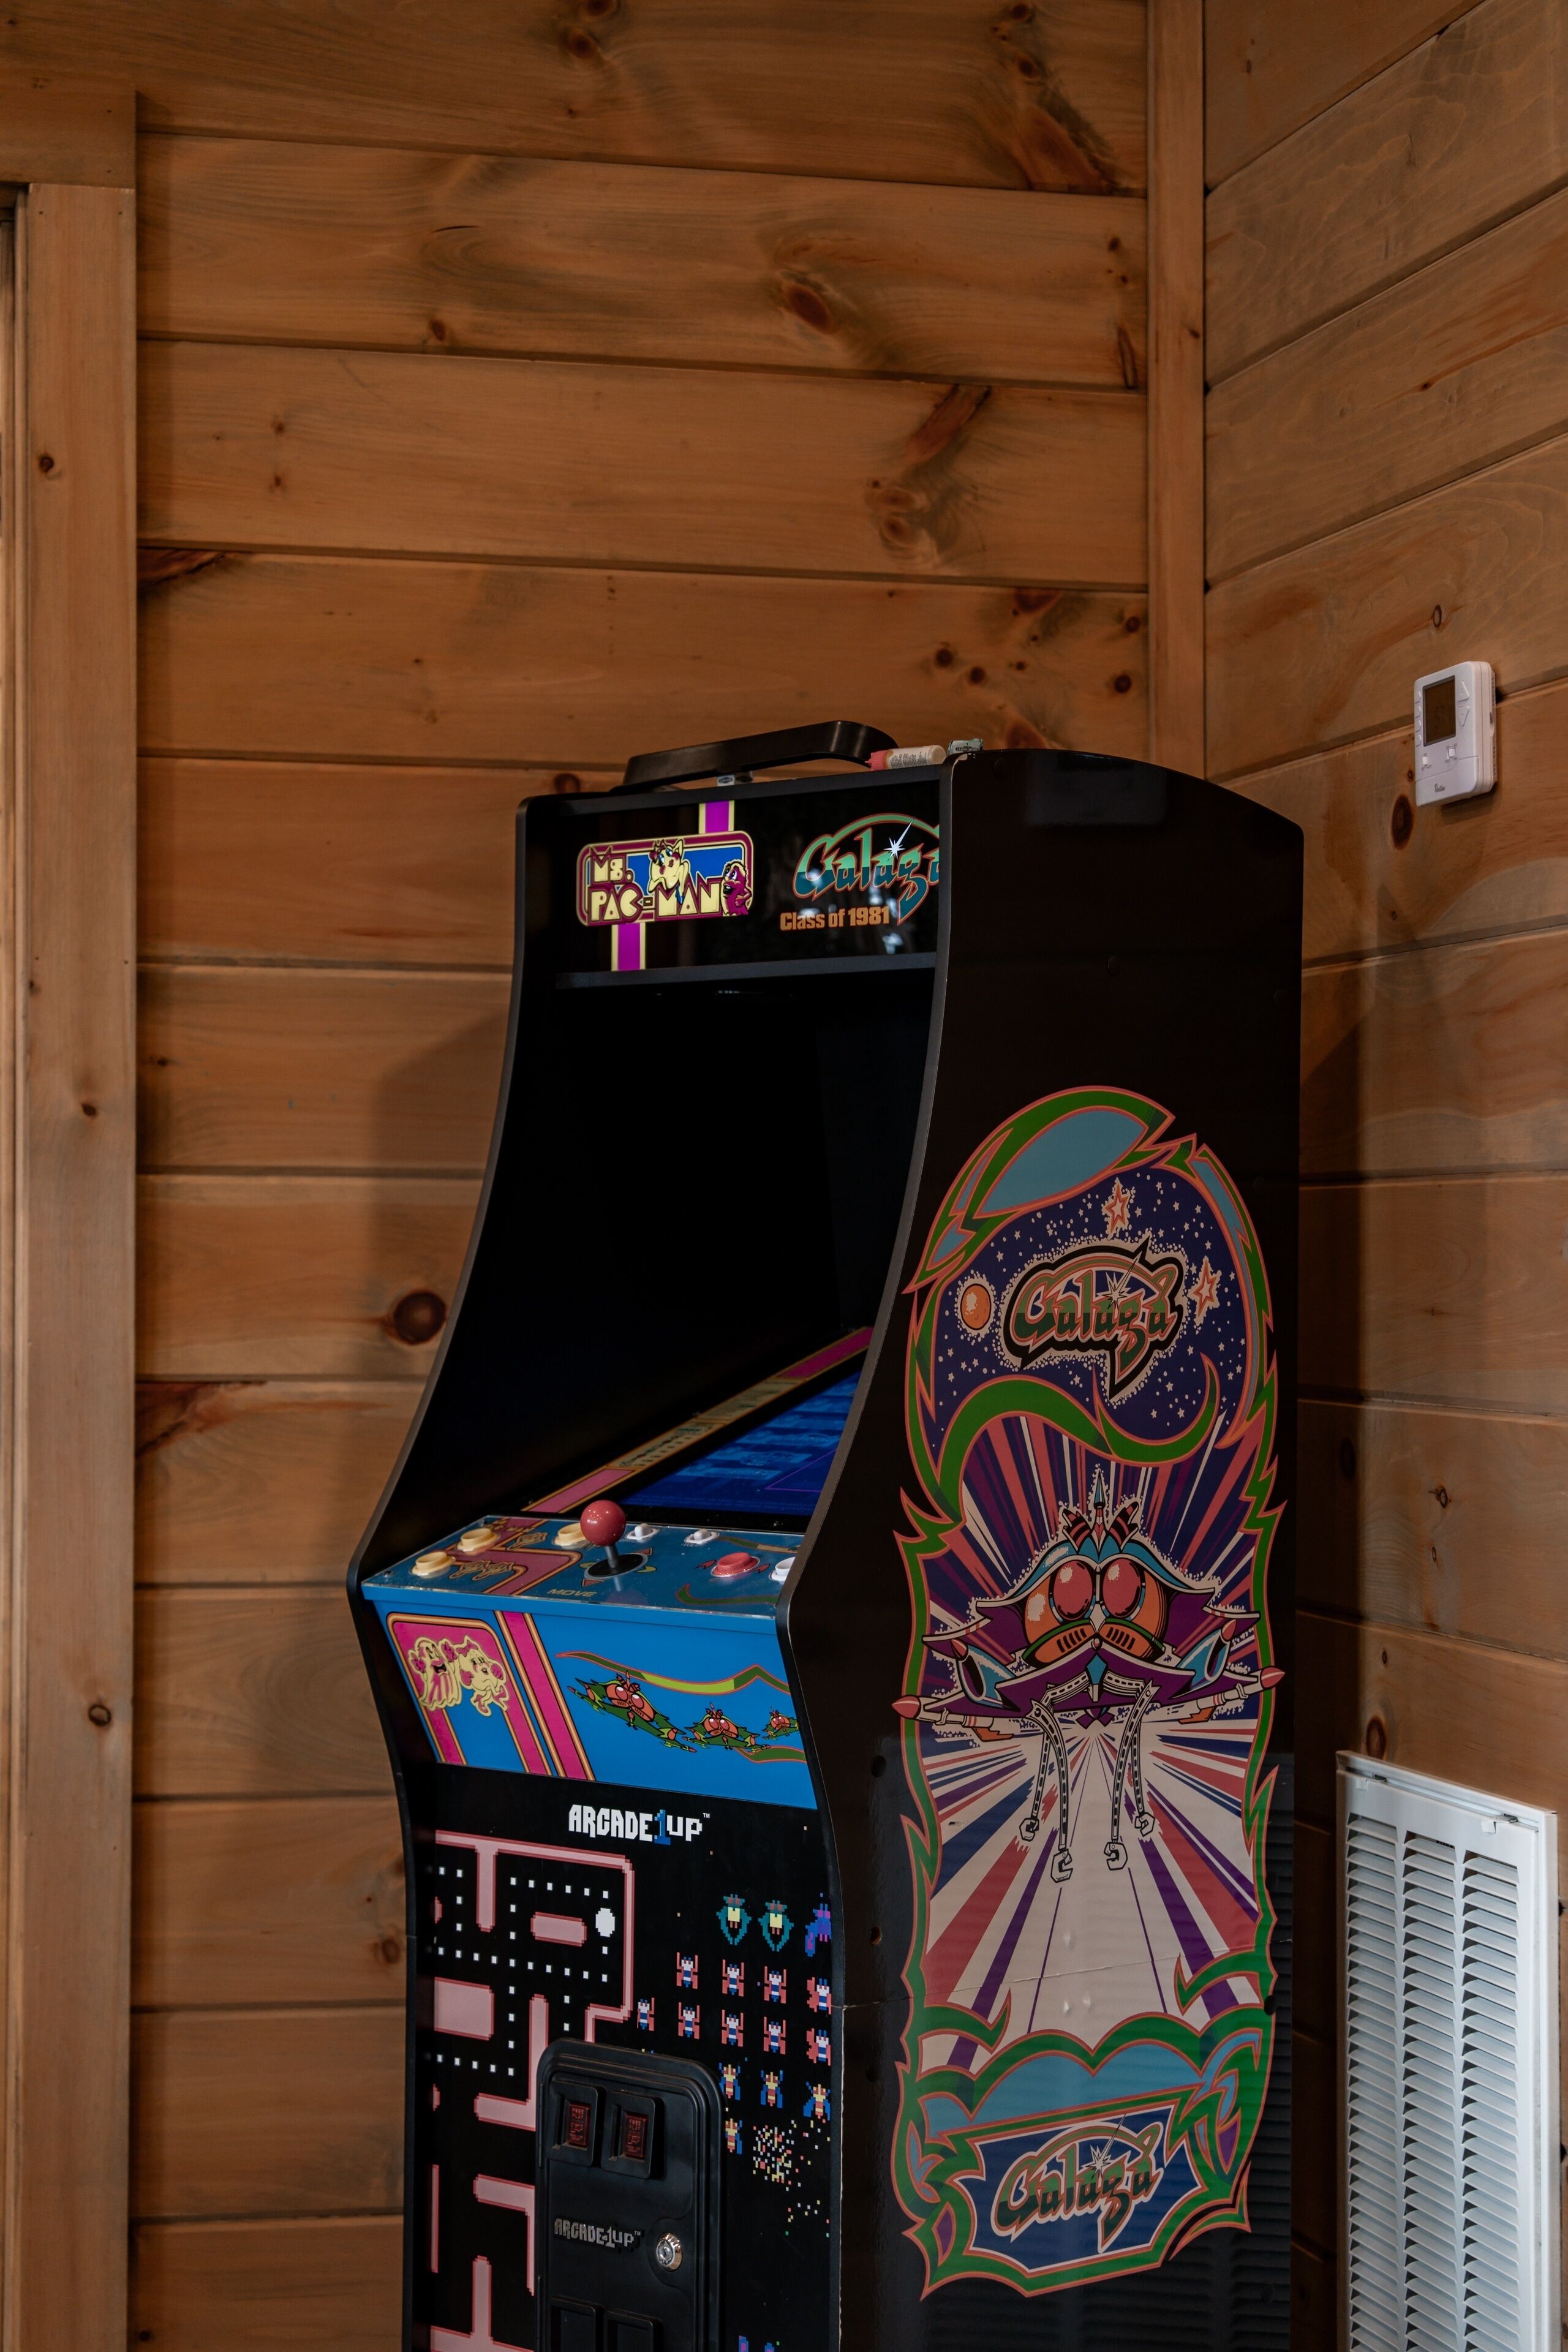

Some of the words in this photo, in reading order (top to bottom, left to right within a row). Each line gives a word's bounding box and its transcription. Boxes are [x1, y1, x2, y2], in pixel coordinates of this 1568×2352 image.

[588, 873, 723, 922] PAC-MAN
[780, 911, 825, 931] Class
[828, 909, 845, 928] of
[848, 906, 889, 927] 1981
[1011, 1255, 1178, 1379] Galaga
[546, 1588, 597, 1598] MOVE
[995, 2124, 1162, 2251] Galaga
